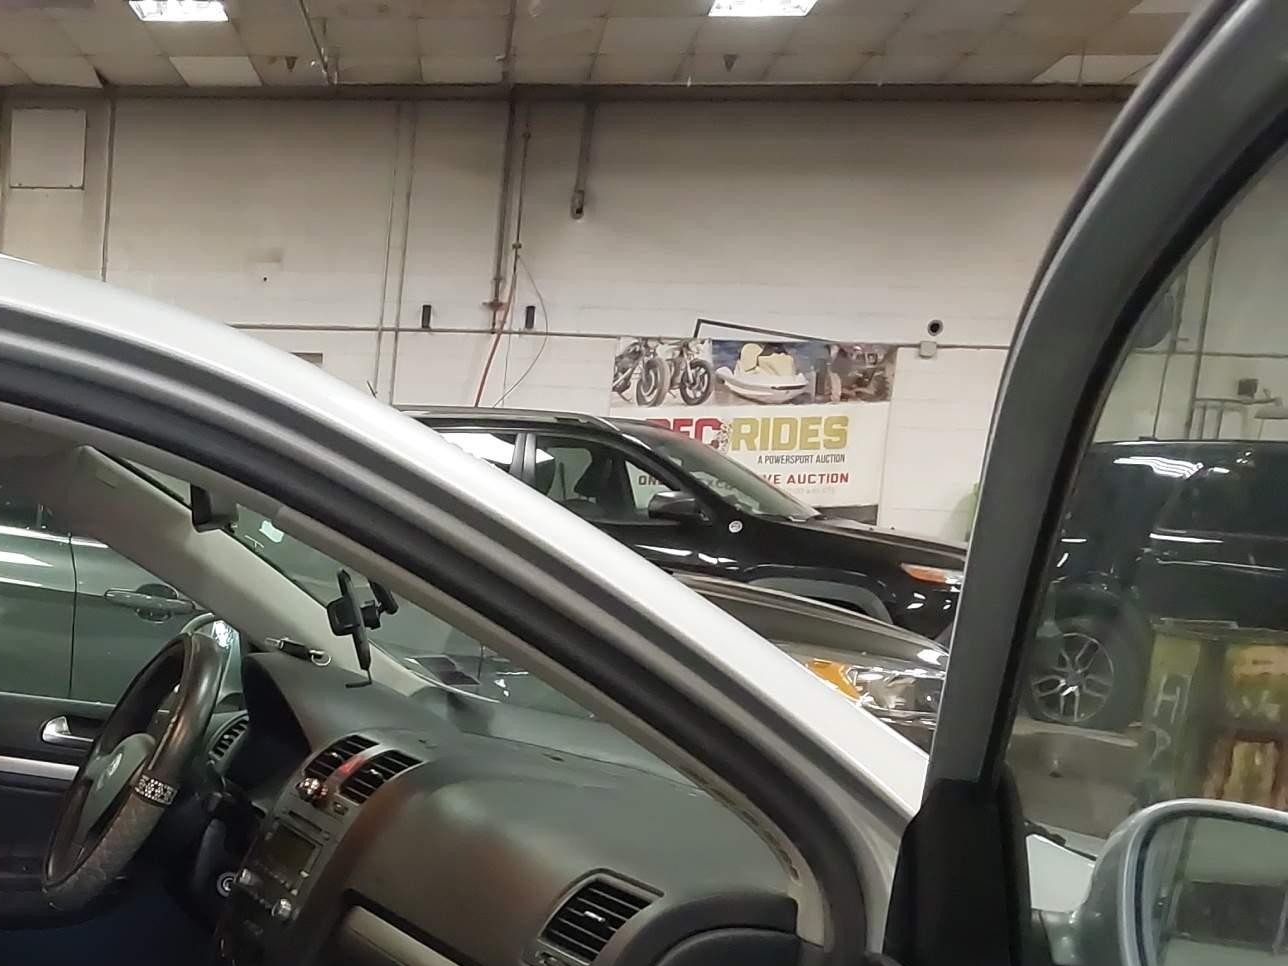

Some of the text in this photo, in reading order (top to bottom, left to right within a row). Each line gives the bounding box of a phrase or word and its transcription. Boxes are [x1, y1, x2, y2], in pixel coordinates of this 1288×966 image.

[730, 416, 849, 451] RIDES
[758, 454, 845, 464] A POWERSPORT AUCTION
[786, 473, 849, 484] AUCTION
